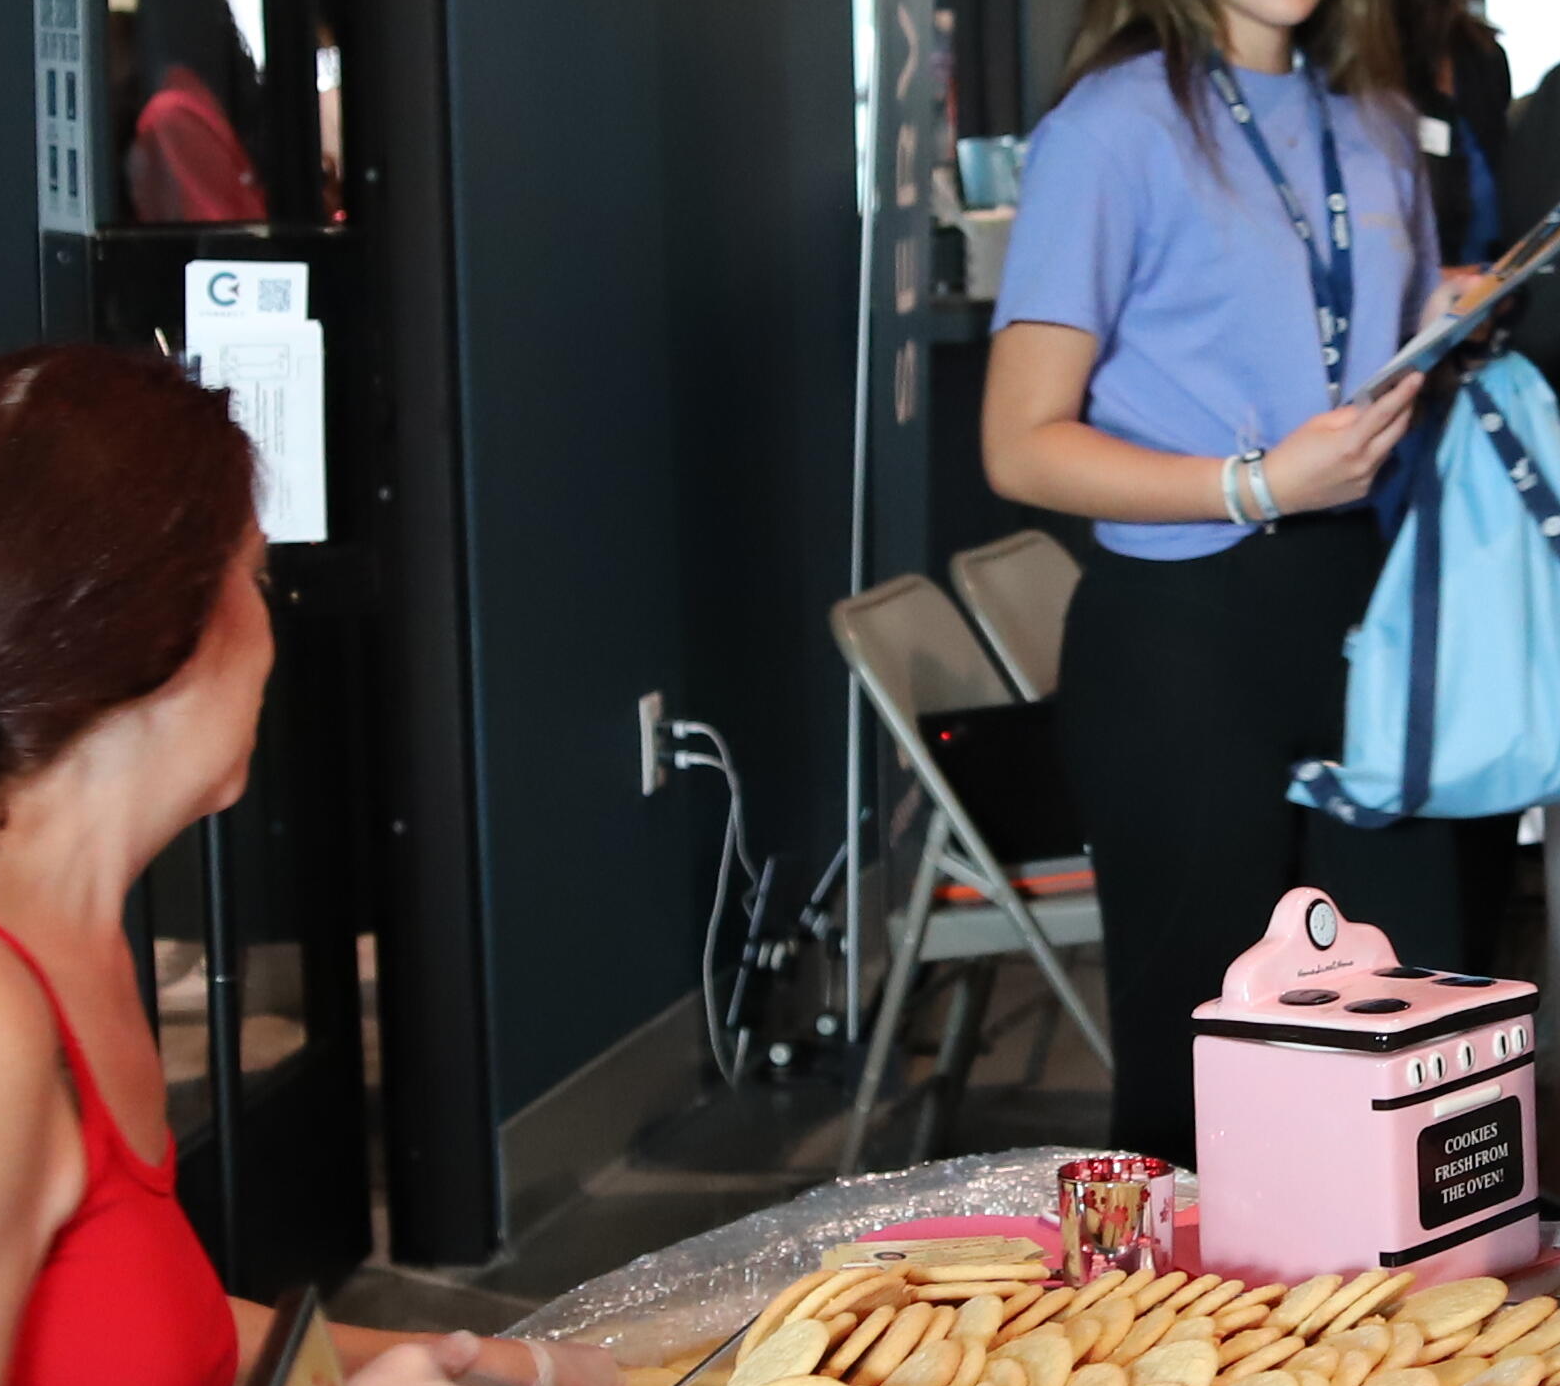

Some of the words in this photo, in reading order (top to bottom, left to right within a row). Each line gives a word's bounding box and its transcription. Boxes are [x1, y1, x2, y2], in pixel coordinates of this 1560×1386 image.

[1444, 1121, 1498, 1155] COOKIES
[1434, 1155, 1473, 1183] FRESH
[1474, 1142, 1509, 1168] FROM
[1441, 1182, 1467, 1204] THE
[1466, 1168, 1504, 1194] OVEN!
